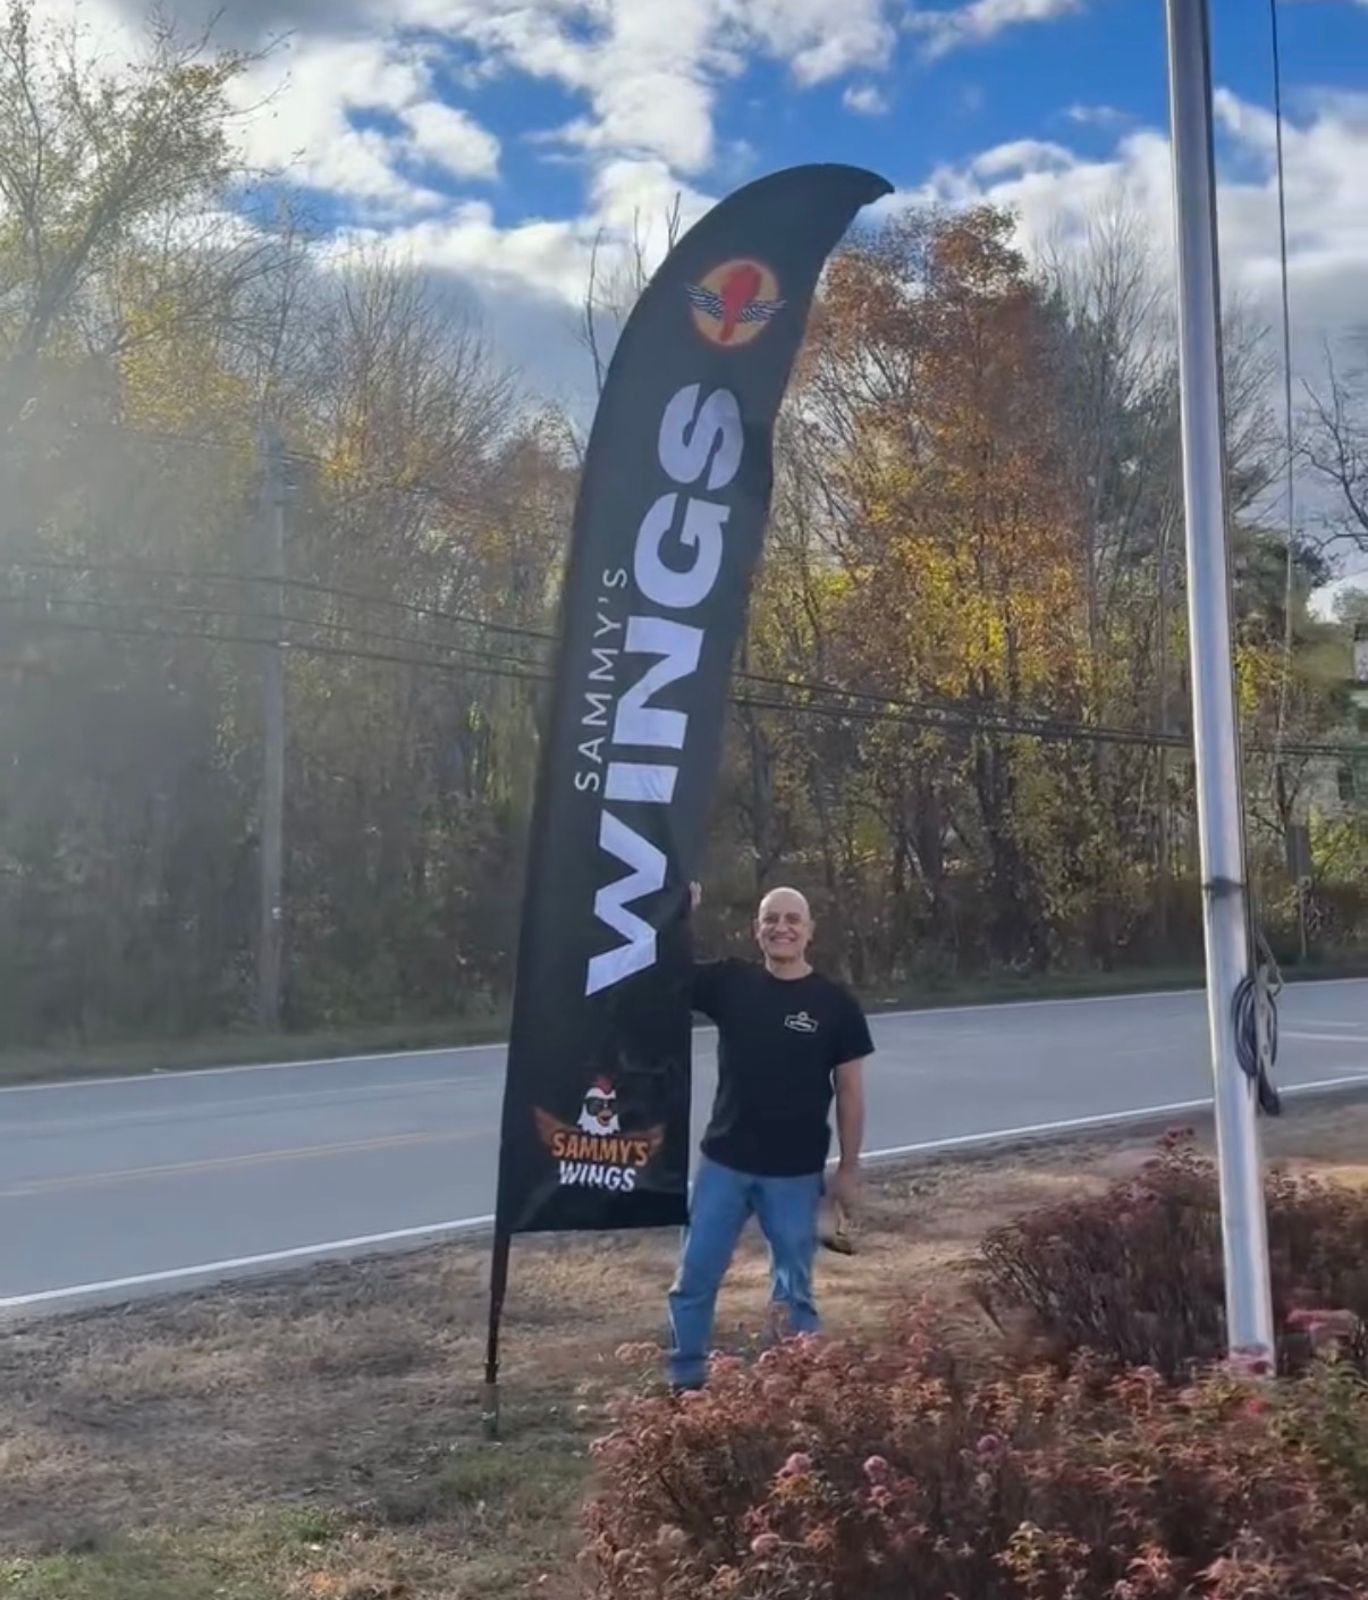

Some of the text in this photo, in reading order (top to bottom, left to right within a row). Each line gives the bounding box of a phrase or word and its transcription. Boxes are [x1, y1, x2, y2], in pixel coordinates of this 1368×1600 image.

[574, 567, 628, 793] SAMMY'S
[585, 383, 743, 996] WINGS
[552, 1132, 648, 1166] SAMMY'S
[559, 1161, 637, 1191] WINGS
